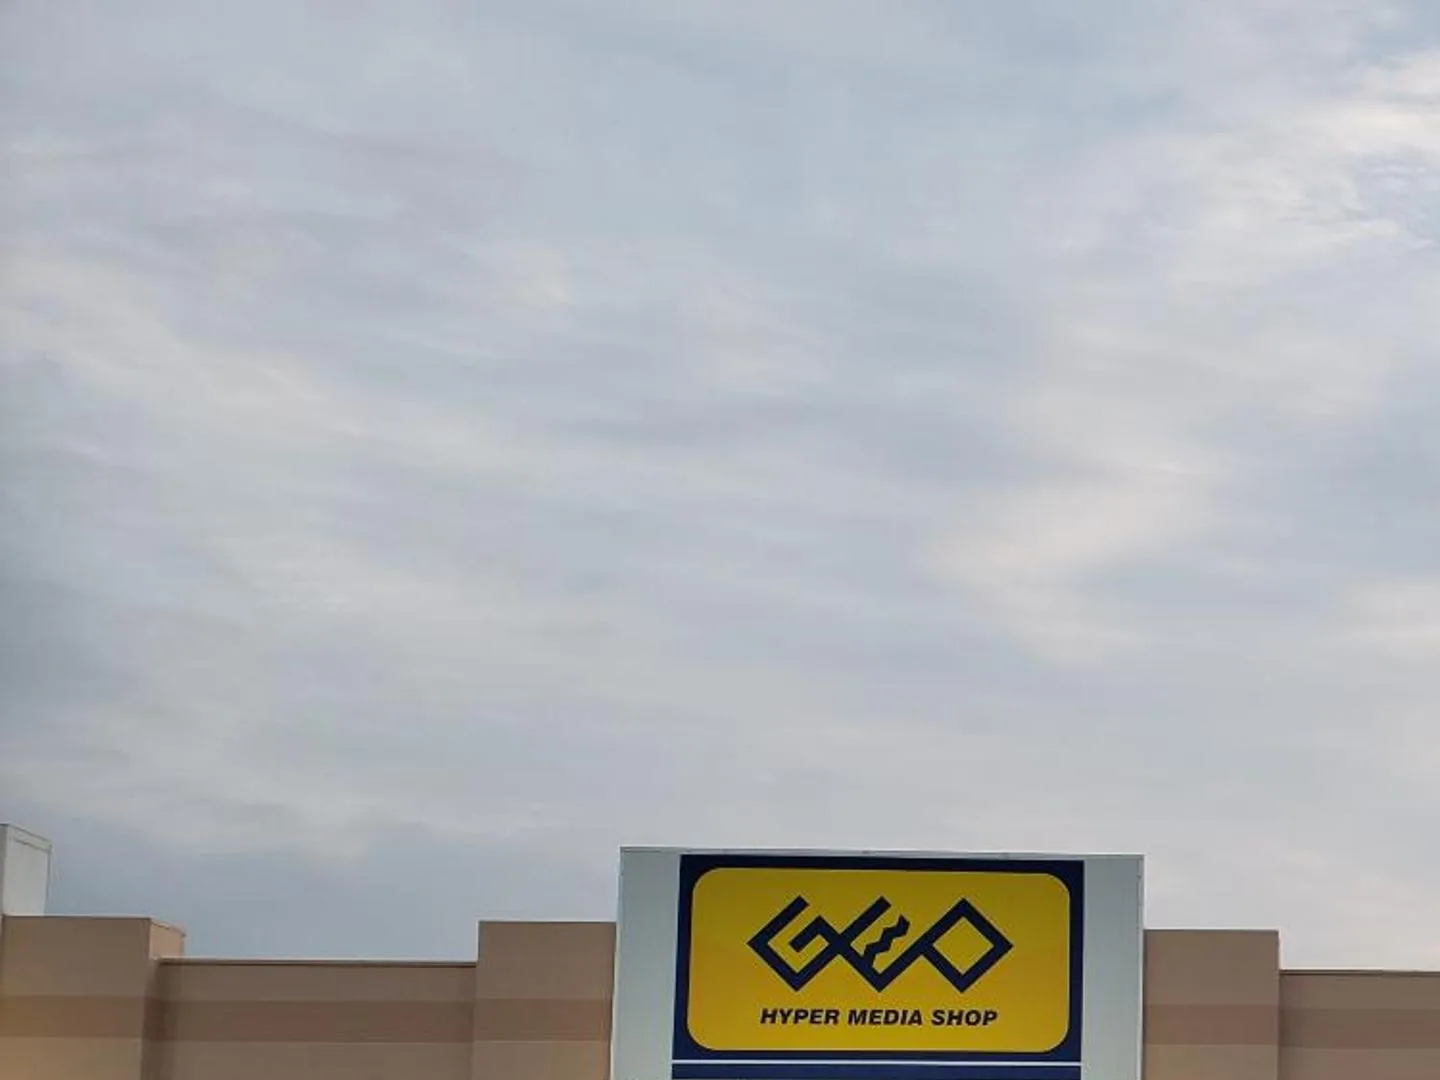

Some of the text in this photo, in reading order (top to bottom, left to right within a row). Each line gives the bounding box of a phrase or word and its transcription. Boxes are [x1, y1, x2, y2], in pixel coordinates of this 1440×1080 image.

[747, 896, 1014, 993] GEO
[760, 1007, 998, 1027] HYPER MEDIA SHOP
